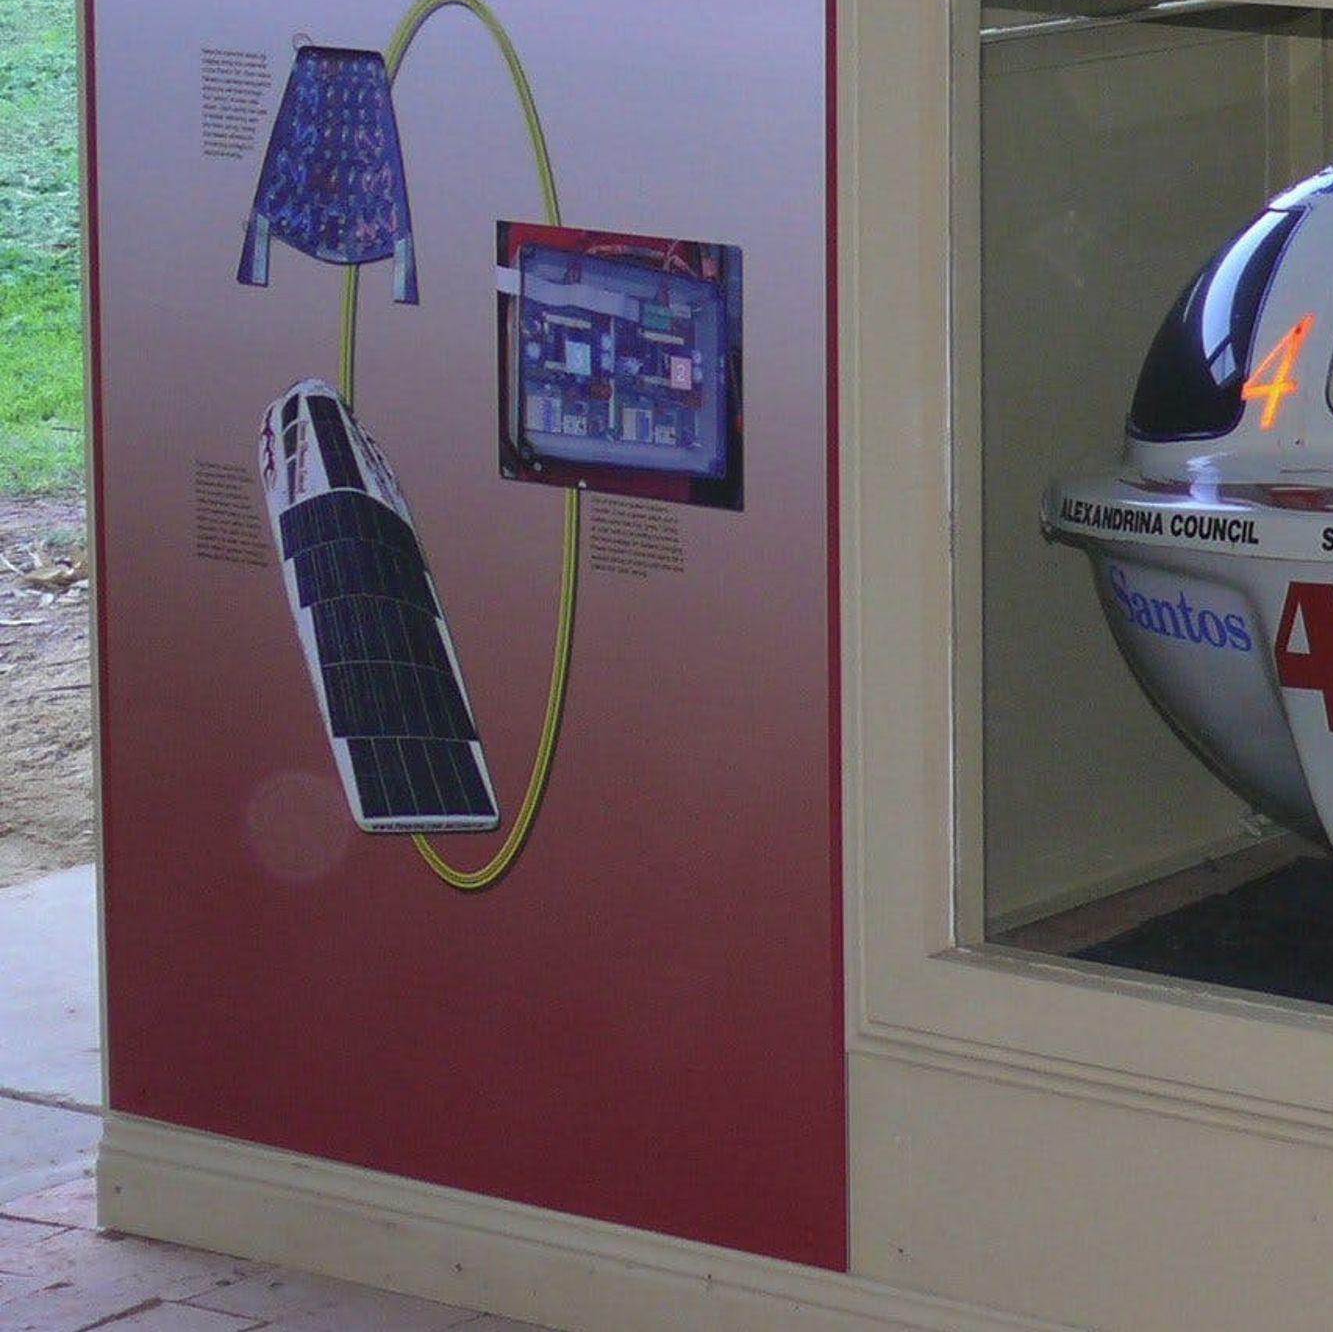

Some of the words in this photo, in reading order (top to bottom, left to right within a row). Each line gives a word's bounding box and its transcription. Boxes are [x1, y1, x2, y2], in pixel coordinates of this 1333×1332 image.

[1241, 311, 1315, 432] 4
[1059, 497, 1164, 537] ALEXANDRINA
[1170, 513, 1260, 545] COUNCIL
[1107, 564, 1252, 653] Santos
